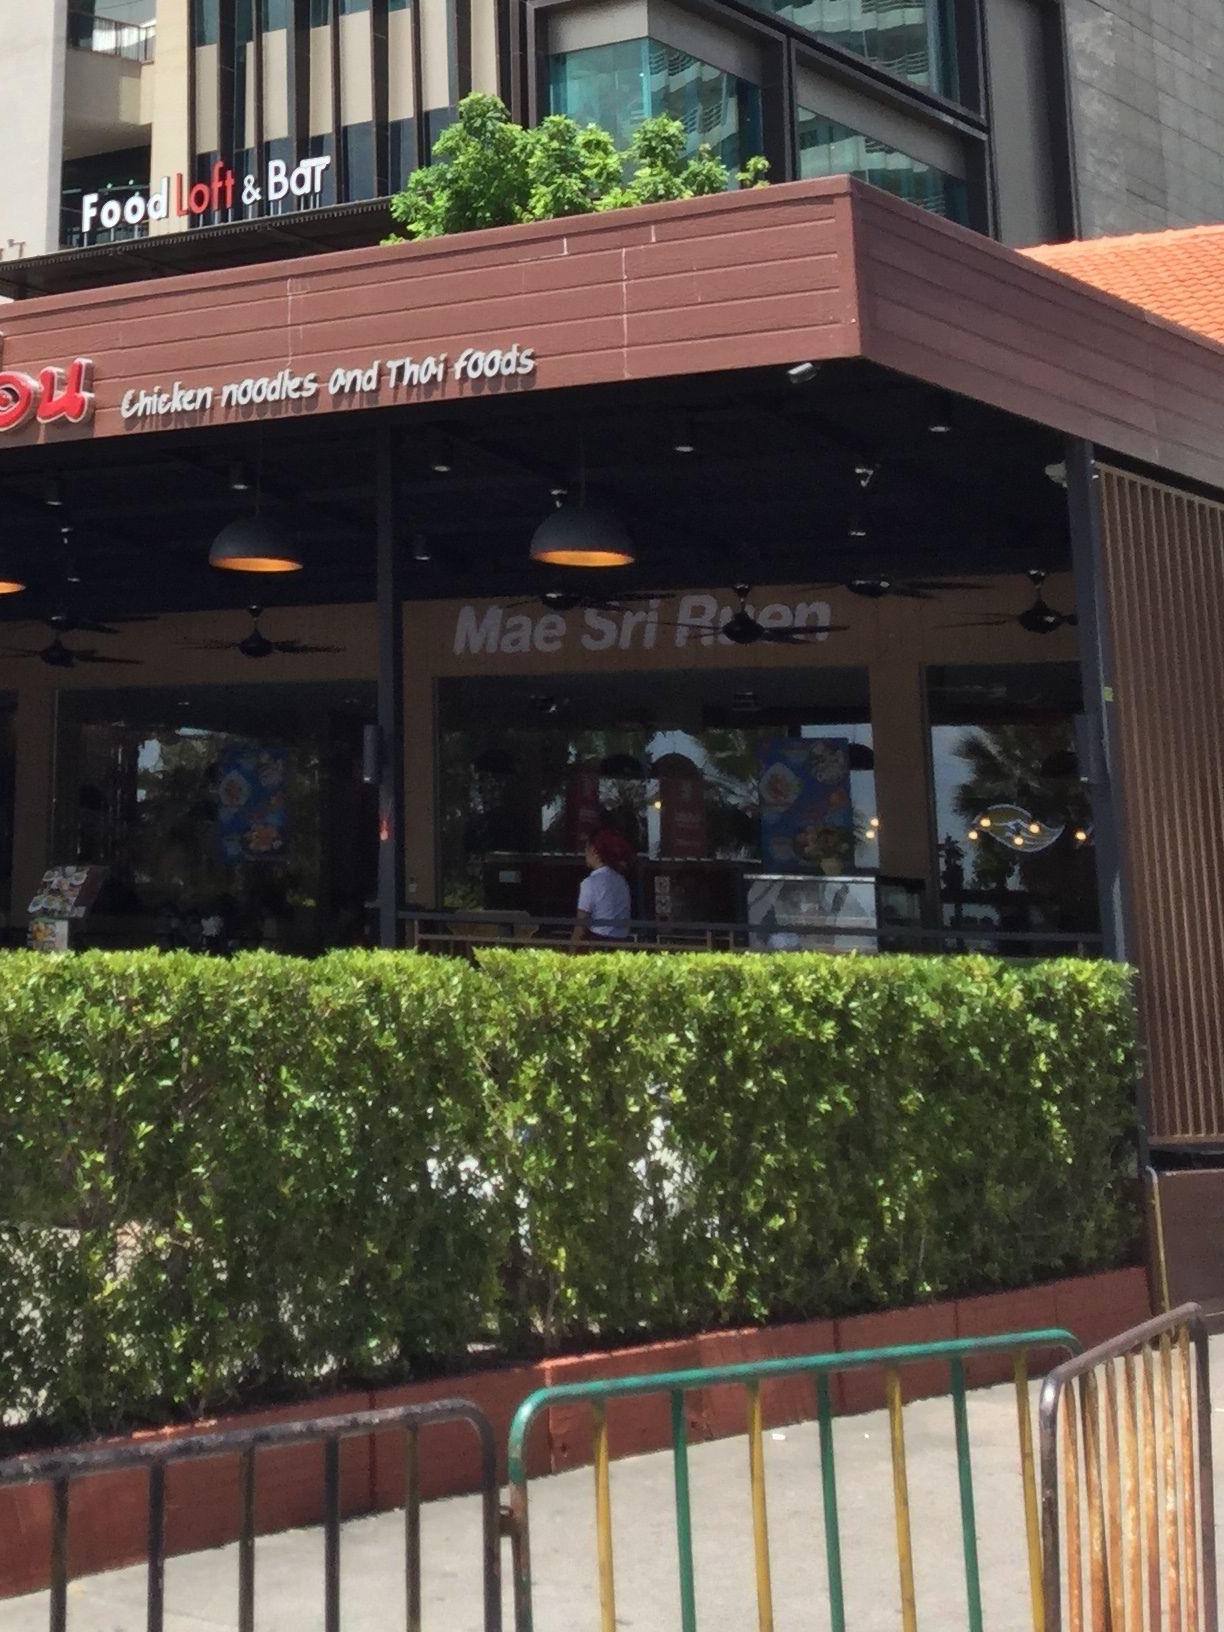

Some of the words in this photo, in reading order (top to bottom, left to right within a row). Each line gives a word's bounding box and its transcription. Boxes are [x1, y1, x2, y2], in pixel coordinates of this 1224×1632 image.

[81, 175, 171, 233] Food
[175, 160, 235, 217] Loft
[241, 174, 262, 206] &
[120, 380, 212, 419] Chicken
[220, 368, 317, 408] noodles
[328, 359, 380, 396] and
[386, 352, 448, 389] Thai
[453, 343, 537, 382] foods
[453, 605, 567, 655] Mae
[581, 598, 660, 652] Sri
